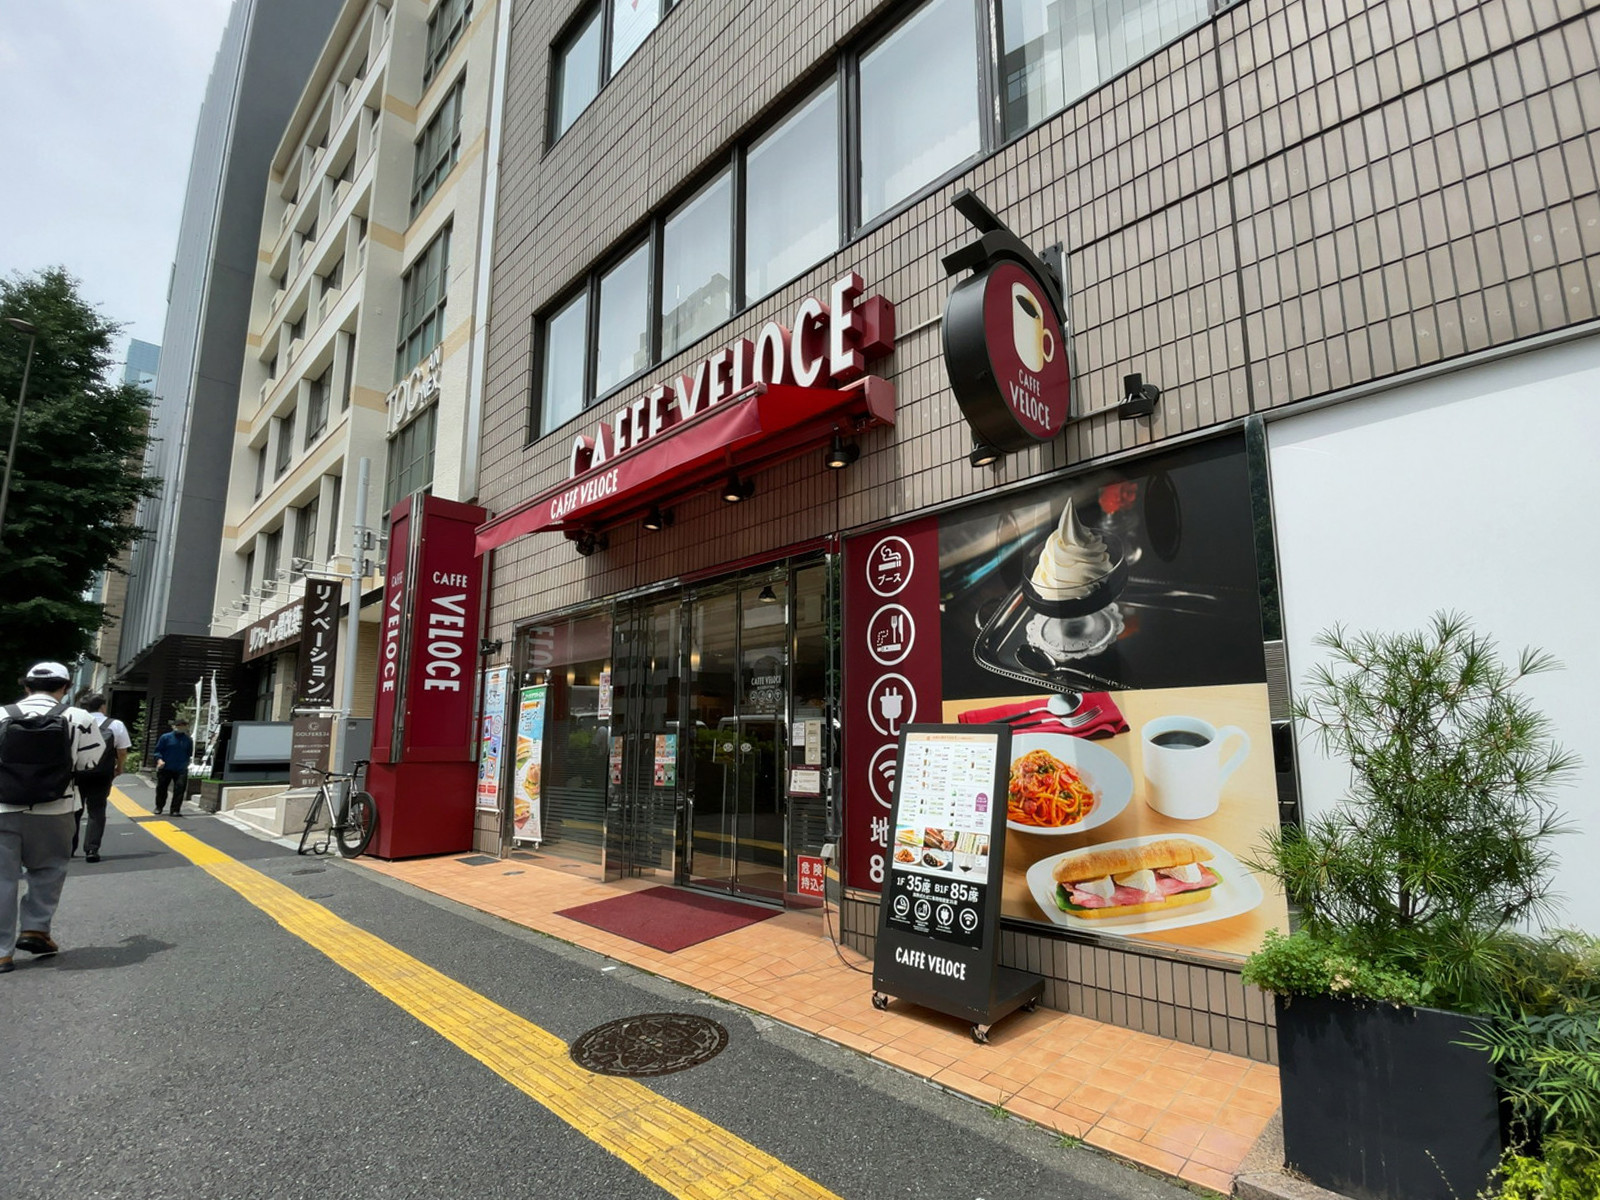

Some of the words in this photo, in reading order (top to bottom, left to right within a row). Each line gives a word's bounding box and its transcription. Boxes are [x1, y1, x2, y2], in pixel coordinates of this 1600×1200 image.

[674, 271, 854, 422] VELOCE
[385, 367, 422, 433] TOC
[1009, 380, 1051, 430] VELOCE
[580, 468, 619, 504] VELOCE
[877, 573, 902, 586] ブース
[307, 584, 331, 694] リノベーション
[382, 590, 402, 693] VELOCE
[423, 593, 467, 692] VELOCE
[896, 877, 906, 886] 1F
[934, 883, 949, 895] B1F
[927, 954, 967, 981] VELOCE
